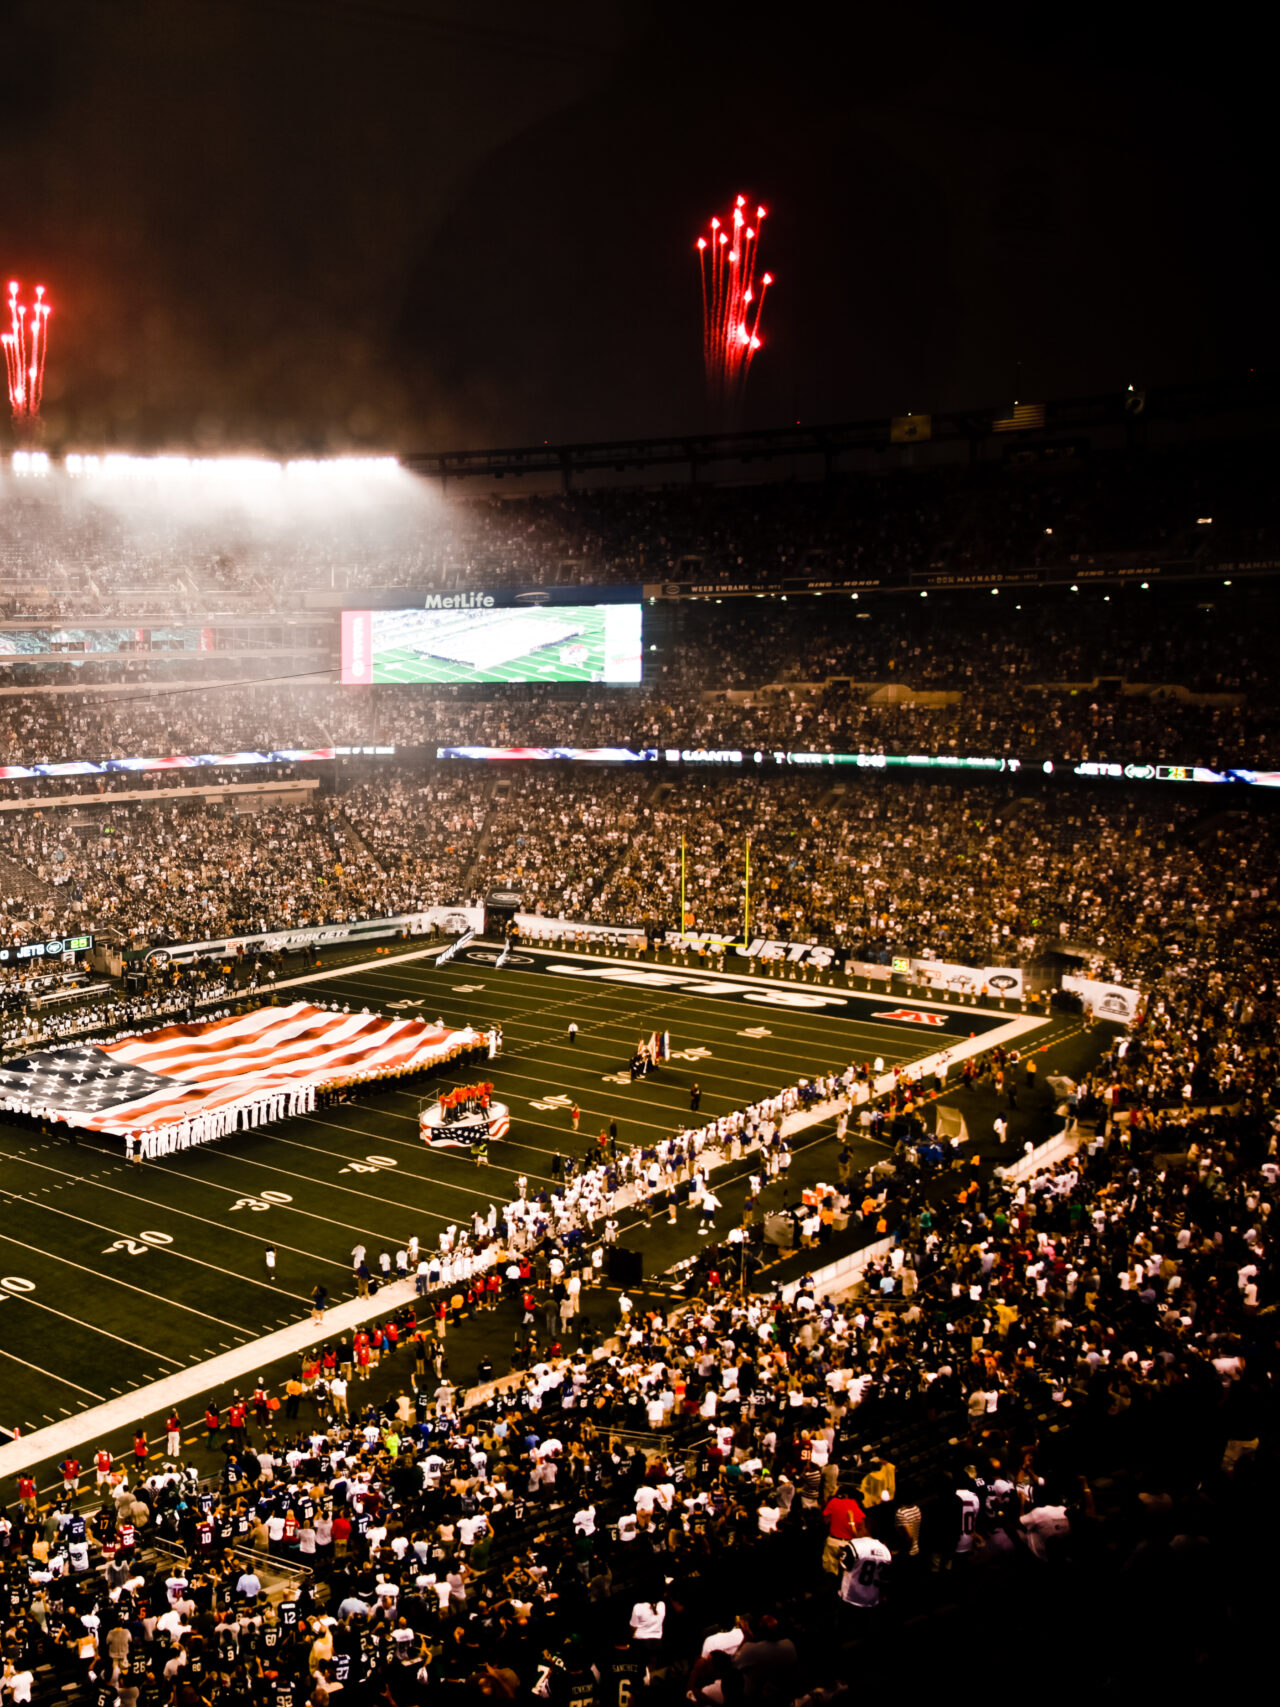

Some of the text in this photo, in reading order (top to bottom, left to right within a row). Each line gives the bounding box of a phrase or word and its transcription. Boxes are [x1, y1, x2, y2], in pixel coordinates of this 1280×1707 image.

[956, 574, 1004, 583] MAYNARD
[691, 585, 714, 593] WEEB
[715, 583, 749, 592] EWBANK
[425, 592, 495, 609] MetLife
[1167, 768, 1186, 779] 25
[291, 933, 321, 945] YORK
[320, 929, 351, 940] JETS
[0, 950, 9, 960] 0
[17, 944, 45, 958] JETS
[70, 938, 87, 949] 25
[735, 938, 835, 967] JETS
[893, 959, 908, 972] 25
[546, 964, 848, 1007] JETS
[736, 1027, 772, 1038] 10
[671, 1047, 713, 1061] 20
[528, 1093, 573, 1111] 40
[347, 1155, 398, 1173] 40
[234, 1190, 294, 1212] 30
[111, 1230, 174, 1256] 20
[801, 1451, 811, 1460] 91
[100, 1520, 108, 1529] 17
[201, 1532, 211, 1544] 10
[284, 1612, 296, 1624] 12
[227, 1650, 234, 1661] 9
[133, 1663, 146, 1674] 26
[336, 1666, 350, 1680] 27
[612, 1664, 639, 1673] SANCHEZ
[618, 1678, 632, 1707] 6
